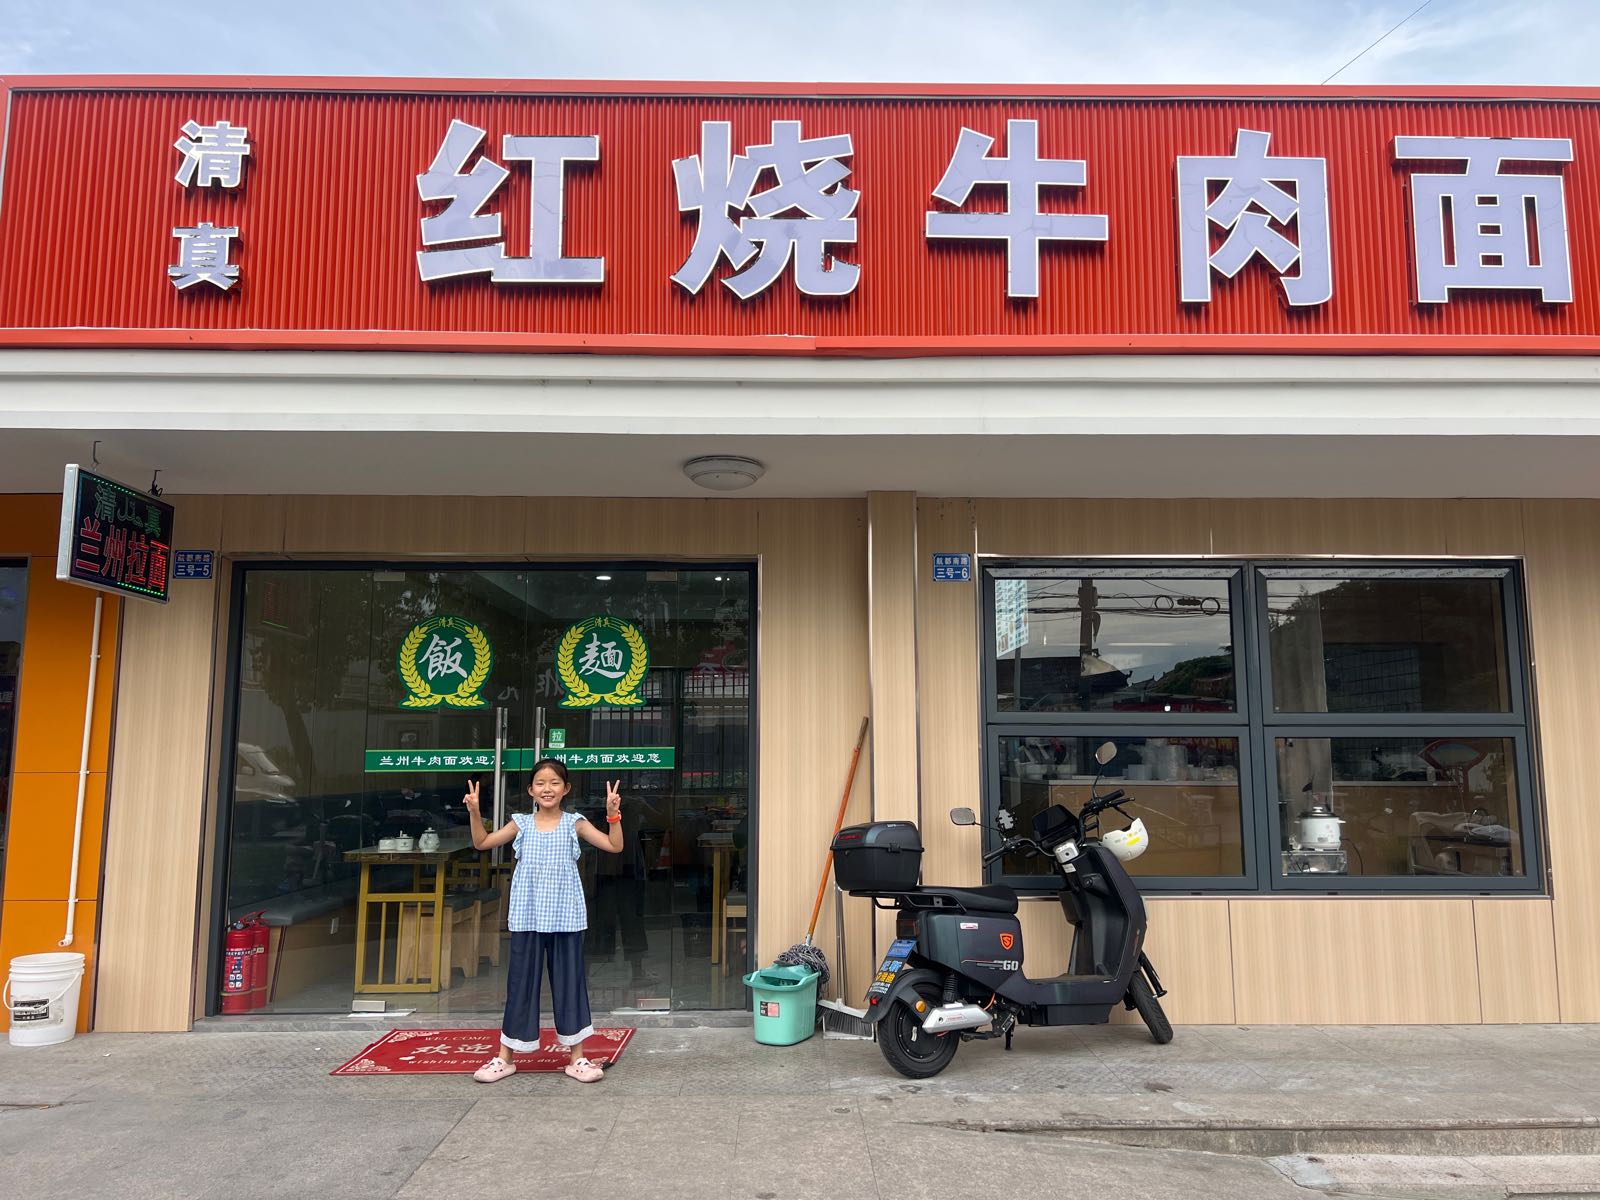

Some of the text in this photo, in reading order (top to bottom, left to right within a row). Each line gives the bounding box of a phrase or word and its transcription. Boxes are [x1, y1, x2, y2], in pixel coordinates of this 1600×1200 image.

[168, 119, 251, 292] 清真
[416, 118, 1574, 307] 红烧牛肉面
[95, 484, 117, 523] 清
[76, 515, 169, 592] 兰州拉面
[176, 564, 210, 576] 三号-5
[936, 567, 968, 579] 三号-6
[551, 730, 563, 742] 拉
